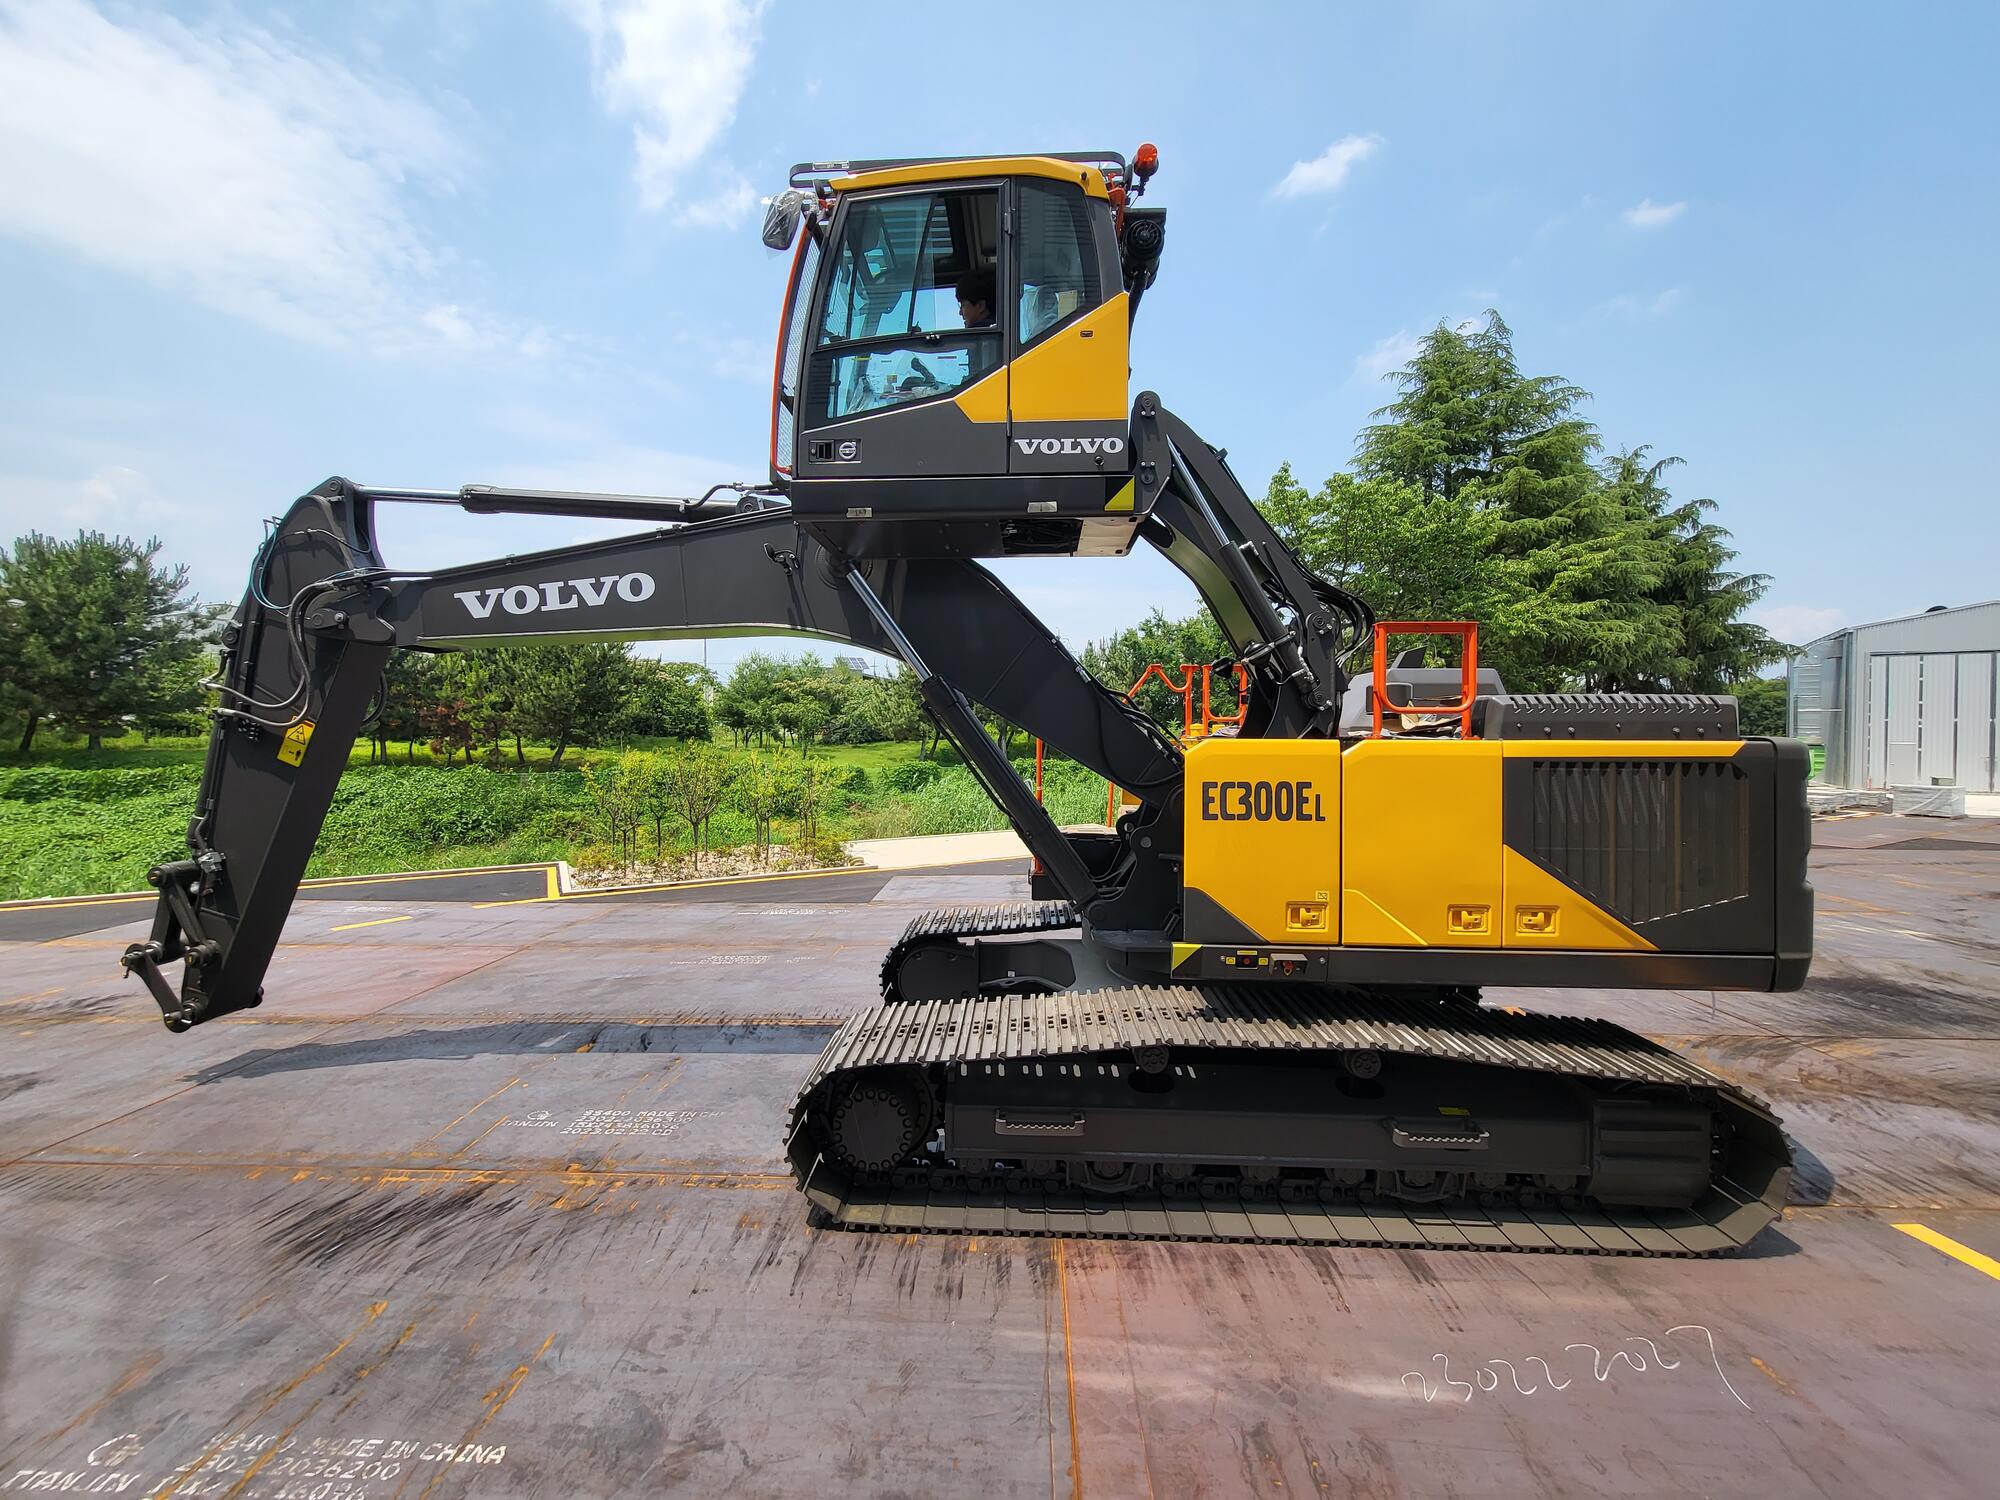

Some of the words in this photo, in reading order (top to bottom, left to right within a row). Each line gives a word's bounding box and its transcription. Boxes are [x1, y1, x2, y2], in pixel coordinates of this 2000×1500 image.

[1014, 437, 1124, 454] VOLVO
[453, 572, 656, 619] VOLVO
[636, 1110, 677, 1118] MADE
[382, 1440, 420, 1460] IN
[419, 1443, 508, 1465] CHINA
[1, 1470, 140, 1493] TIANJIN
